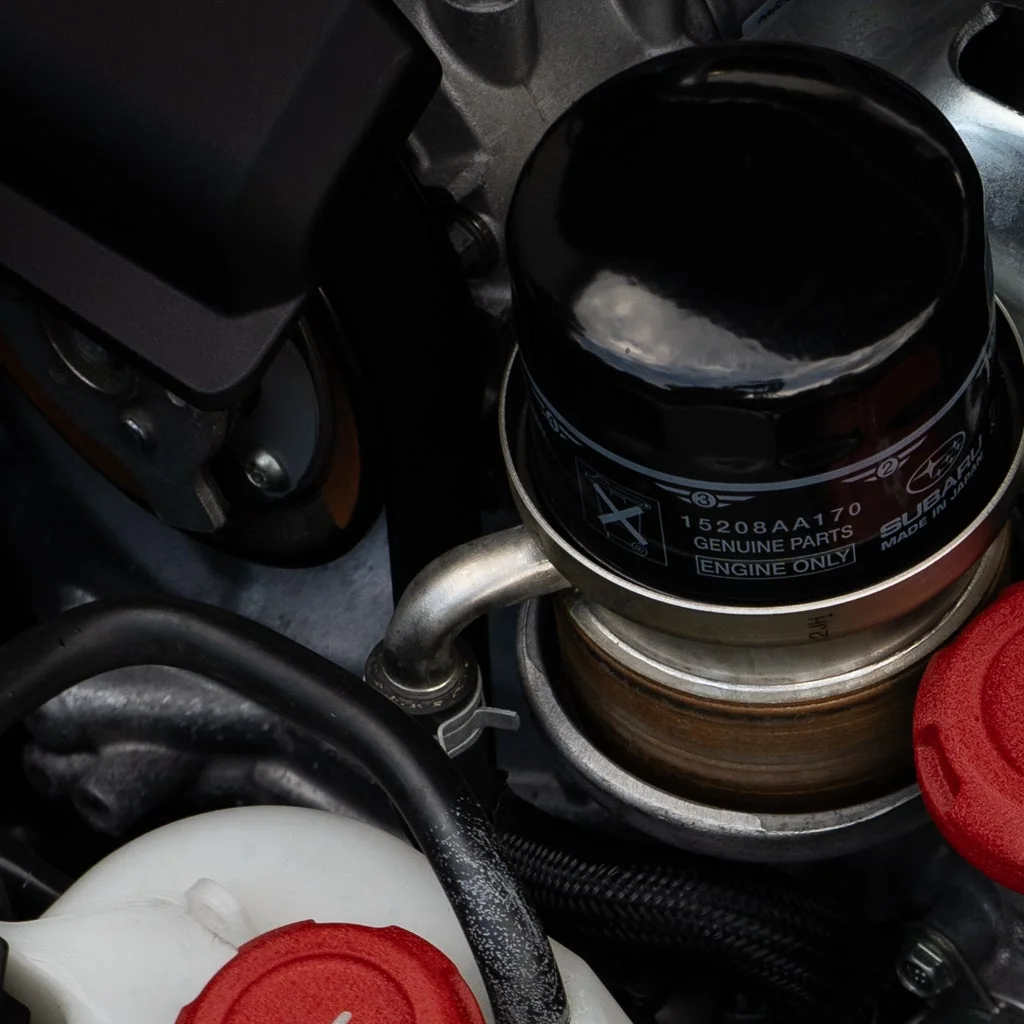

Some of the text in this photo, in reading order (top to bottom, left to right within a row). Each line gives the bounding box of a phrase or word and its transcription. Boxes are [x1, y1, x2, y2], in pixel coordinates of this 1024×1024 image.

[880, 433, 983, 539] SUBARU
[880, 450, 984, 552] MADE IN JAPAN
[680, 502, 861, 534] 15208AA170
[693, 525, 854, 554] GENUINE PARTS
[700, 549, 852, 577] ENGINE ONLY
